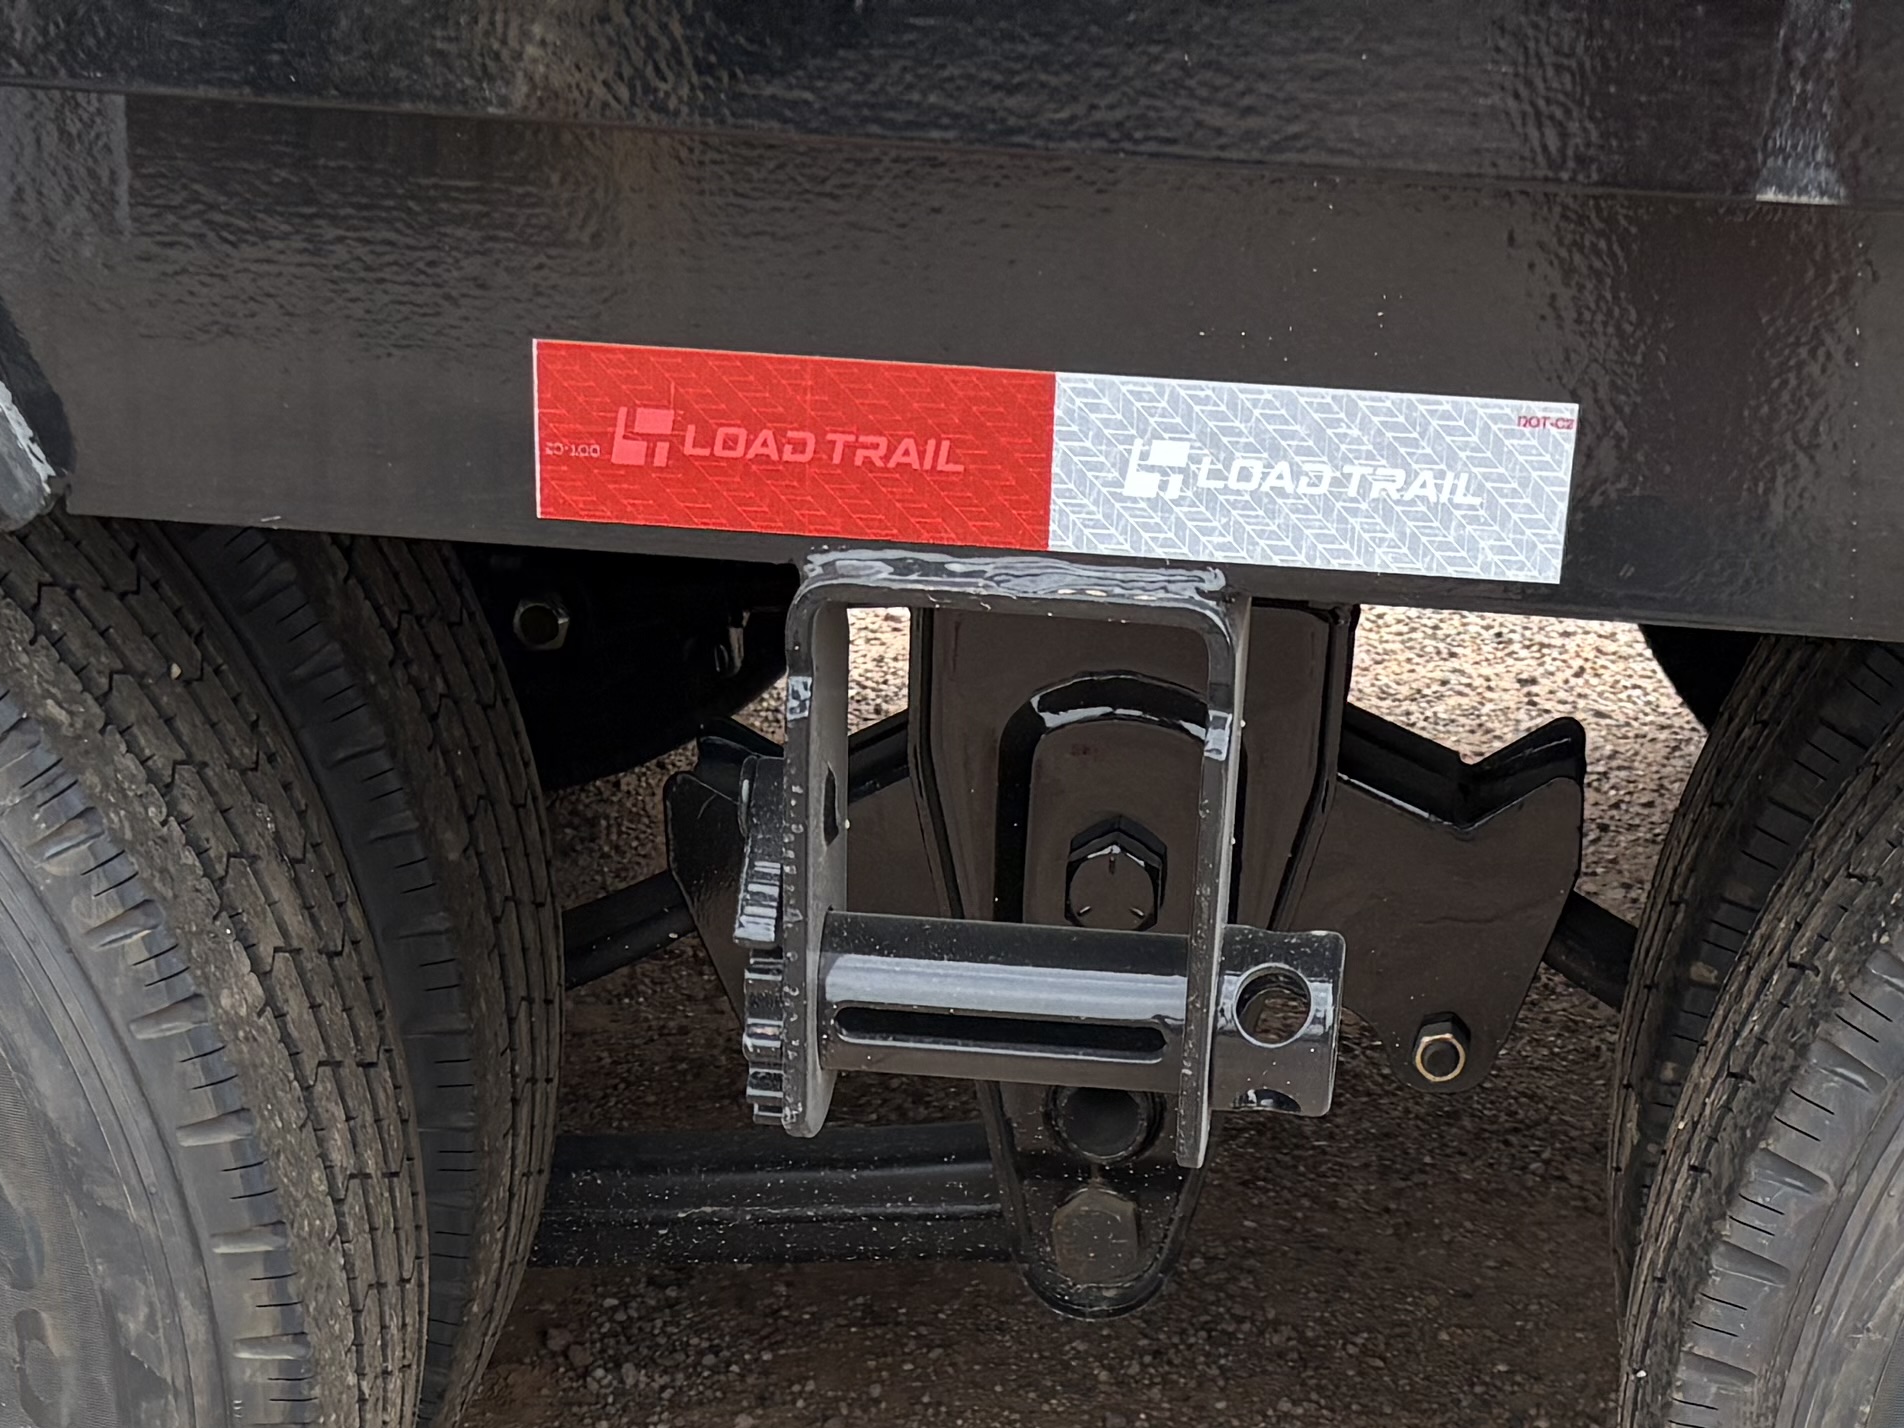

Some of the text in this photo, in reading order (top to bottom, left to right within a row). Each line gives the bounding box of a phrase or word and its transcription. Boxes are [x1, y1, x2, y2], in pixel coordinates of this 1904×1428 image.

[1517, 415, 1575, 431] DOT-C2
[683, 423, 965, 473] LOAD TRAIL
[1196, 456, 1484, 505] LOAD TRAIL
